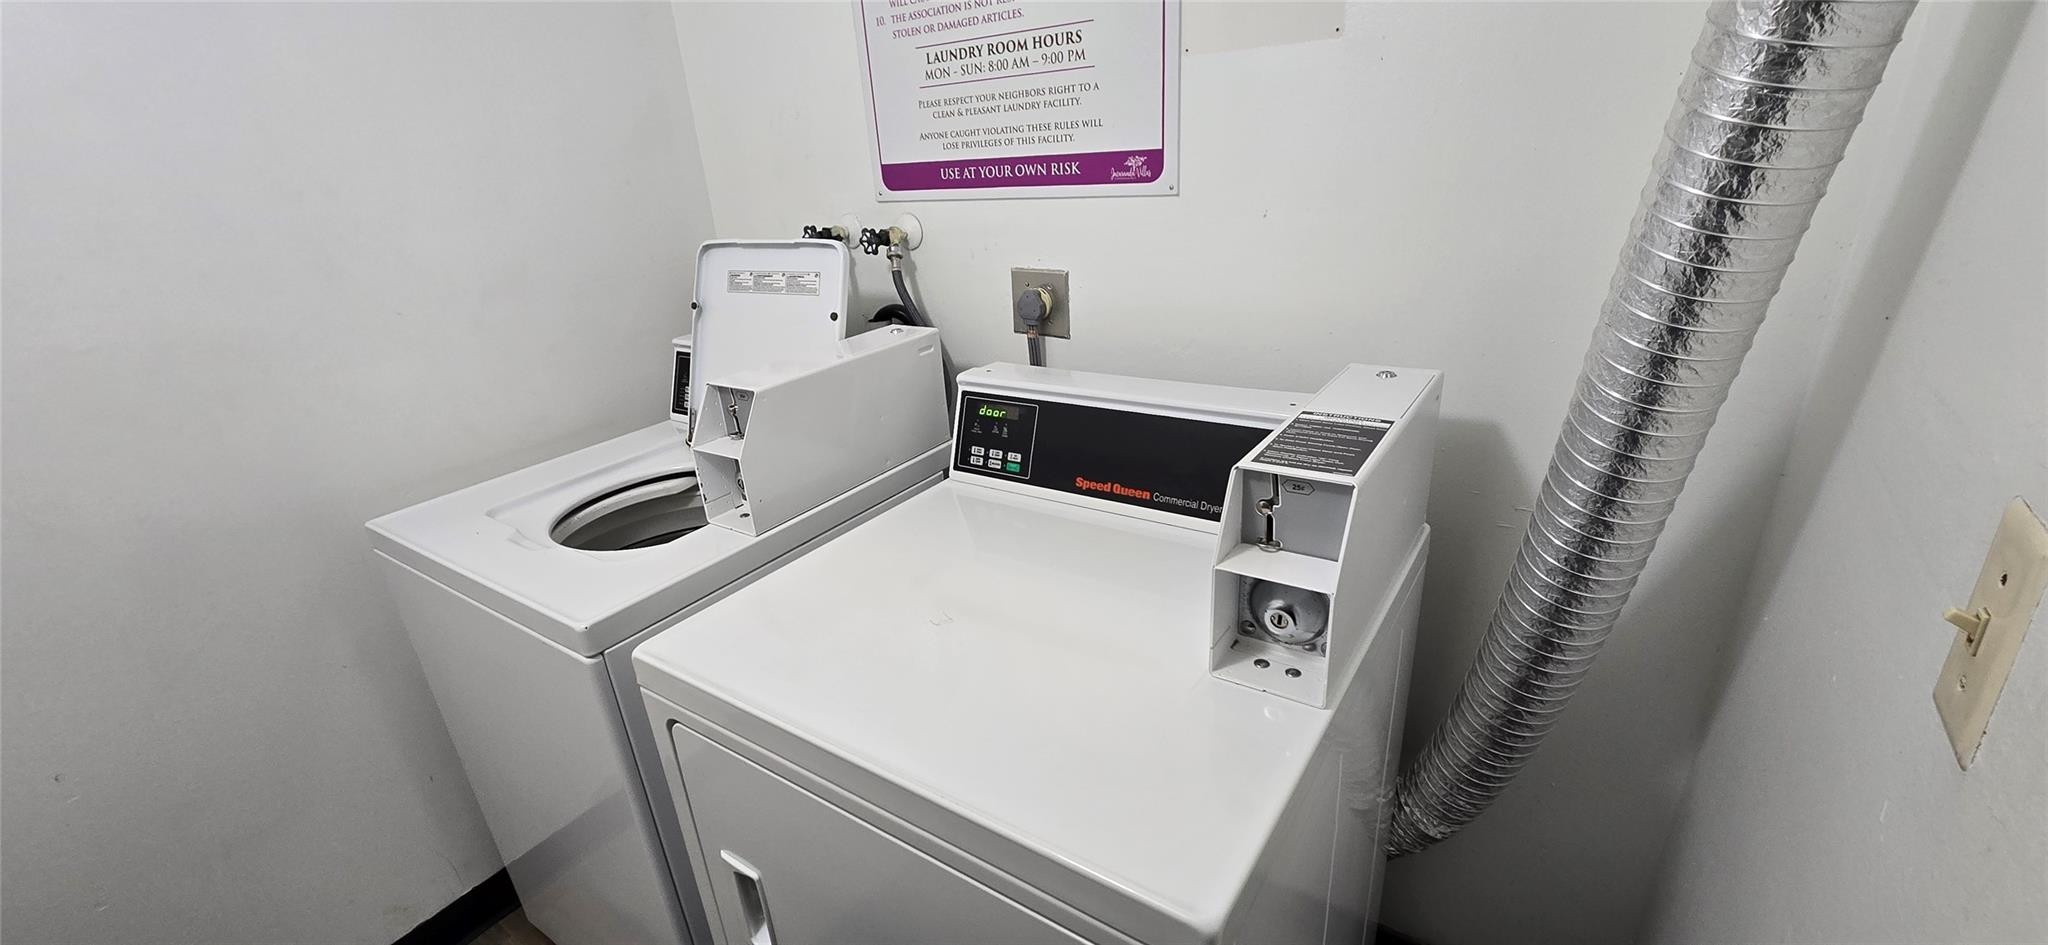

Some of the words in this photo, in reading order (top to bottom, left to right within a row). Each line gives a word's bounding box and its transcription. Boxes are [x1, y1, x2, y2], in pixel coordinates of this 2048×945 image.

[876, 16, 887, 26] 10.
[891, 13, 907, 24] THE
[909, 3, 962, 20] ASSOCIATION
[964, 1, 972, 10] IS
[892, 27, 921, 39] STOLEN
[923, 24, 936, 34] OR
[937, 16, 979, 31] DAMAGED
[981, 8, 1024, 24] ARTICLES.
[926, 46, 984, 65] LAUNDRY
[987, 39, 1029, 56] ROOM
[1032, 29, 1083, 49] HOURS
[925, 67, 951, 81] MON
[960, 62, 986, 76] SUN:
[988, 59, 1009, 72] 8:00
[1011, 56, 1030, 69] AM
[1041, 51, 1064, 65] 9:00
[1067, 49, 1086, 62] PM
[918, 98, 942, 109] PLEASE
[944, 95, 974, 107] RESPECT
[975, 92, 997, 103] YOUR
[999, 87, 1046, 101] NEIGHBORS
[1048, 84, 1077, 97] RIGHT
[1079, 82, 1092, 92] TO
[1093, 81, 1100, 91] A
[932, 108, 956, 119] CLEAN
[957, 107, 964, 117] &
[965, 104, 1001, 116] PLEASANT
[1003, 101, 1041, 113] LAUNDRY
[1043, 96, 1082, 109] FACILITY.
[919, 131, 948, 141] ANYONE
[950, 128, 981, 139] CAUGHT
[981, 124, 1025, 136] VIOLATING
[1026, 122, 1052, 133] THESE
[1054, 120, 1080, 131] RULES
[1081, 118, 1103, 128] WILL
[942, 141, 960, 150] LOSE
[961, 138, 1002, 149] PRIVILEGES
[1003, 137, 1015, 147] OF
[1016, 135, 1036, 145] THIS
[1038, 133, 1075, 144] FACILITY.
[940, 167, 960, 180] USE
[962, 166, 976, 179] AT
[978, 164, 1013, 178] YOUR
[1015, 163, 1047, 176] OWN
[1051, 161, 1080, 176] RISK
[979, 404, 1007, 418] door
[1075, 476, 1112, 492] Speed
[1112, 483, 1151, 500] Queen
[1152, 492, 1199, 509] Commercial
[1200, 501, 1223, 514] Dryer
